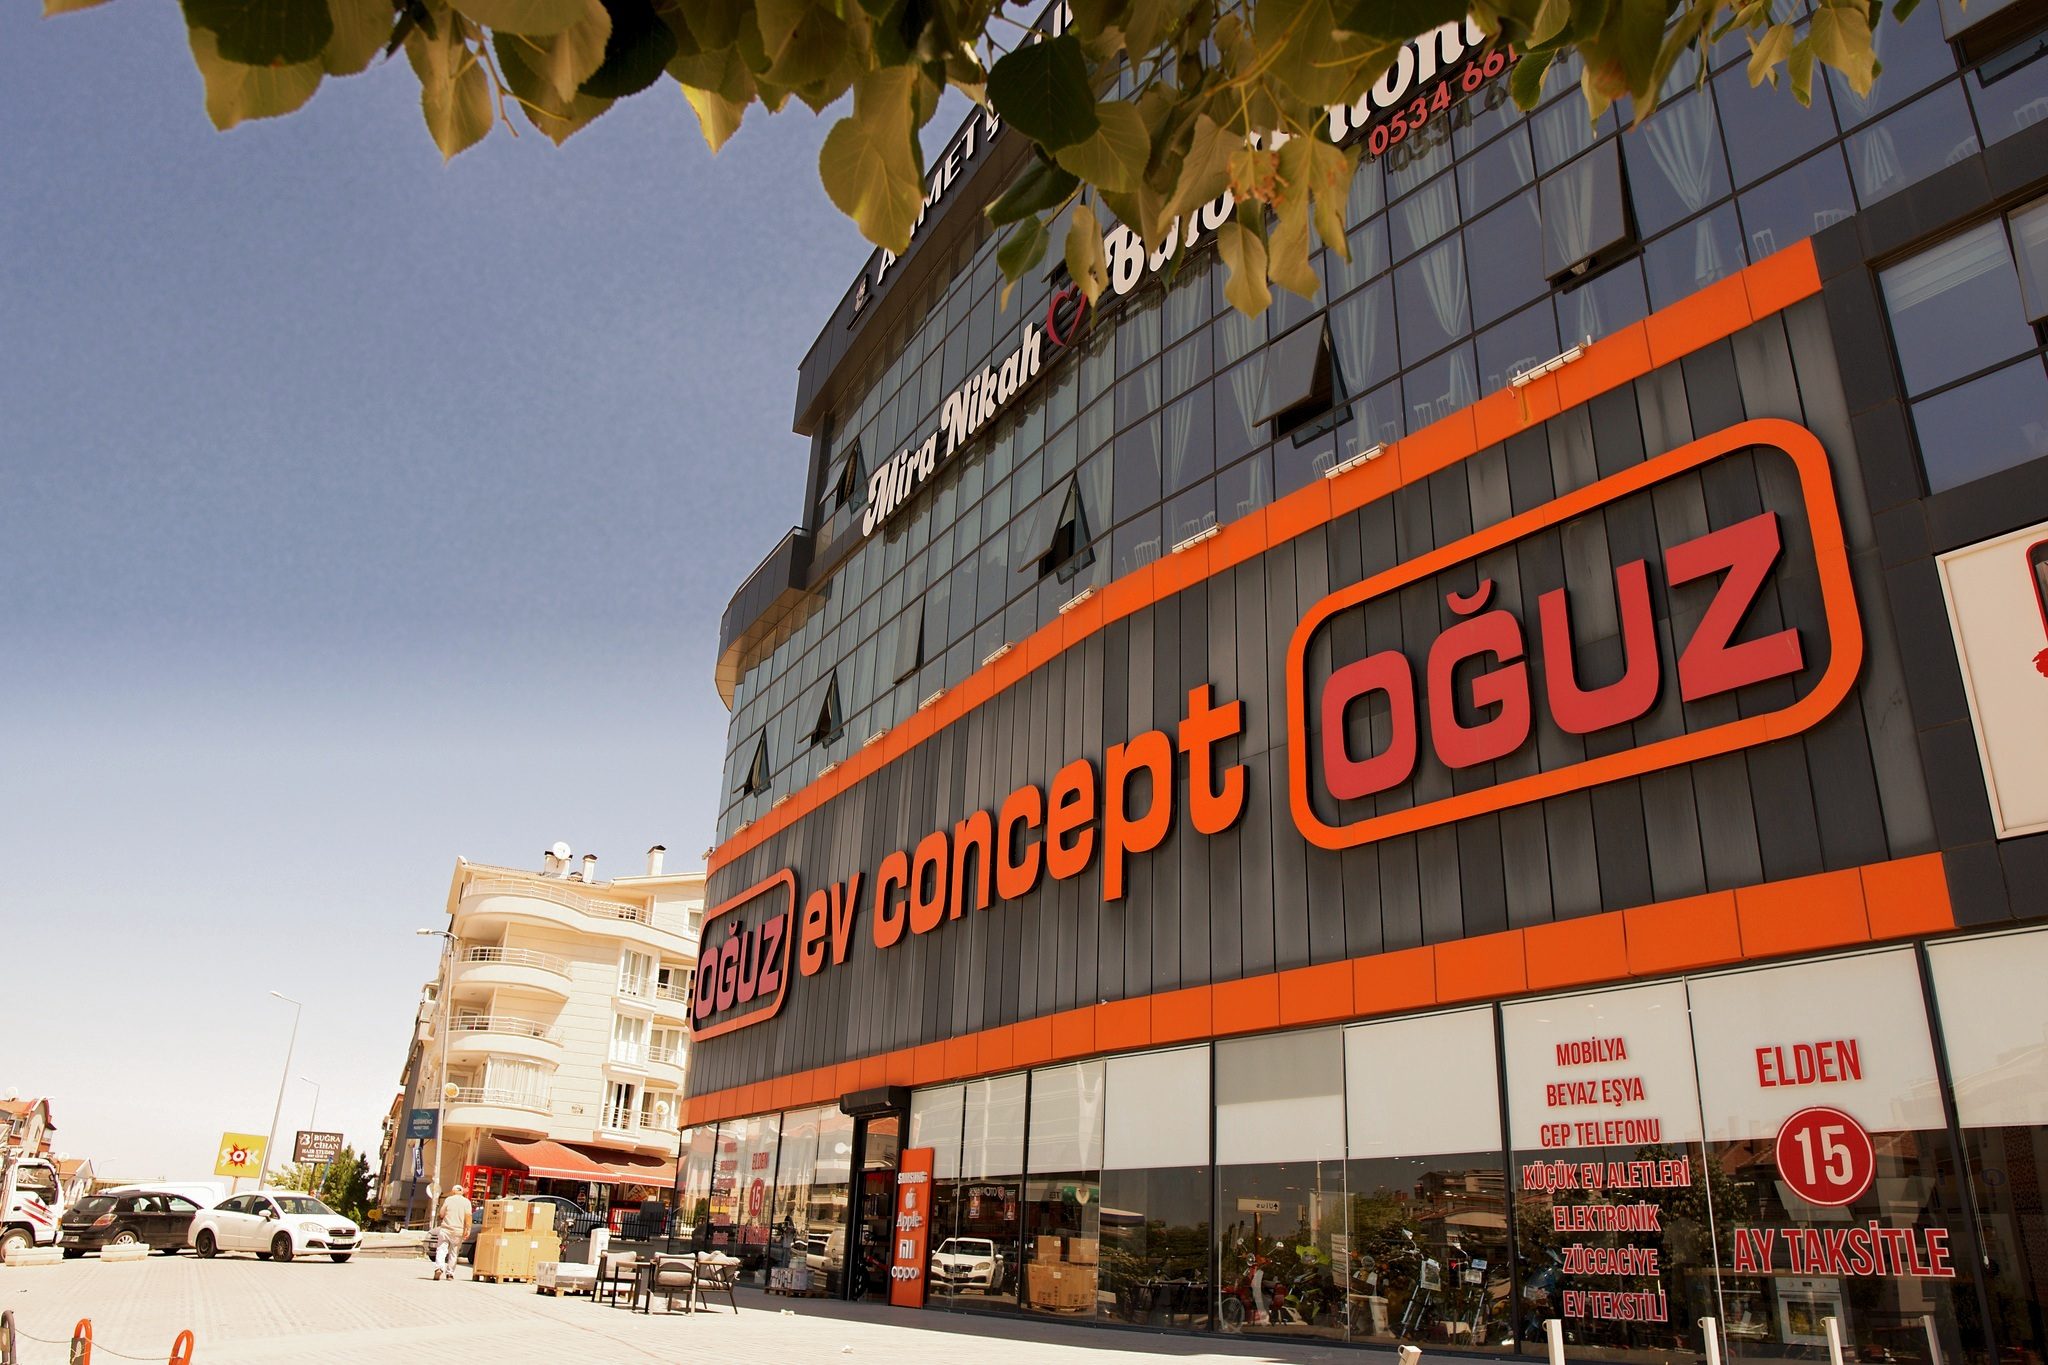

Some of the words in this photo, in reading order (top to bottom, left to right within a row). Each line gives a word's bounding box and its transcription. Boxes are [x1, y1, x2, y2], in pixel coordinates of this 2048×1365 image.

[1368, 80, 1450, 156] 0534
[877, 113, 983, 286] AMET
[862, 432, 938, 537] Mira
[941, 322, 1041, 457] Nikah
[1321, 510, 1804, 801] OĞUZ
[695, 913, 785, 1020] OĞUZ
[800, 872, 864, 976] ev
[873, 682, 1249, 949] concept
[1556, 1036, 1627, 1066] MOBİLYA
[1755, 1039, 1862, 1088] ELDEN
[1546, 1081, 1598, 1106] BEYAZ
[1601, 1078, 1645, 1107] EŞYA
[313, 1142, 339, 1150] CİHAN
[314, 1134, 341, 1143] BUĞRA
[1540, 1123, 1571, 1147] CEP
[1574, 1119, 1662, 1146] TELEFONU
[1794, 1125, 1853, 1186] 15
[1523, 1160, 1578, 1194] KÜÇÜK
[1581, 1163, 1604, 1189] EV
[1607, 1155, 1691, 1189] ALETLERİ
[751, 1186, 760, 1210] 15
[896, 1210, 923, 1232] Apple
[1553, 1200, 1662, 1232] ELEKTRONİK
[1562, 1243, 1660, 1276] ZÜCCACİYE
[1733, 1228, 1774, 1274] AY
[1781, 1219, 1956, 1279] TAKSİTLE
[1563, 1291, 1586, 1317] EV
[1588, 1289, 1668, 1322] TEKSTİLİ
